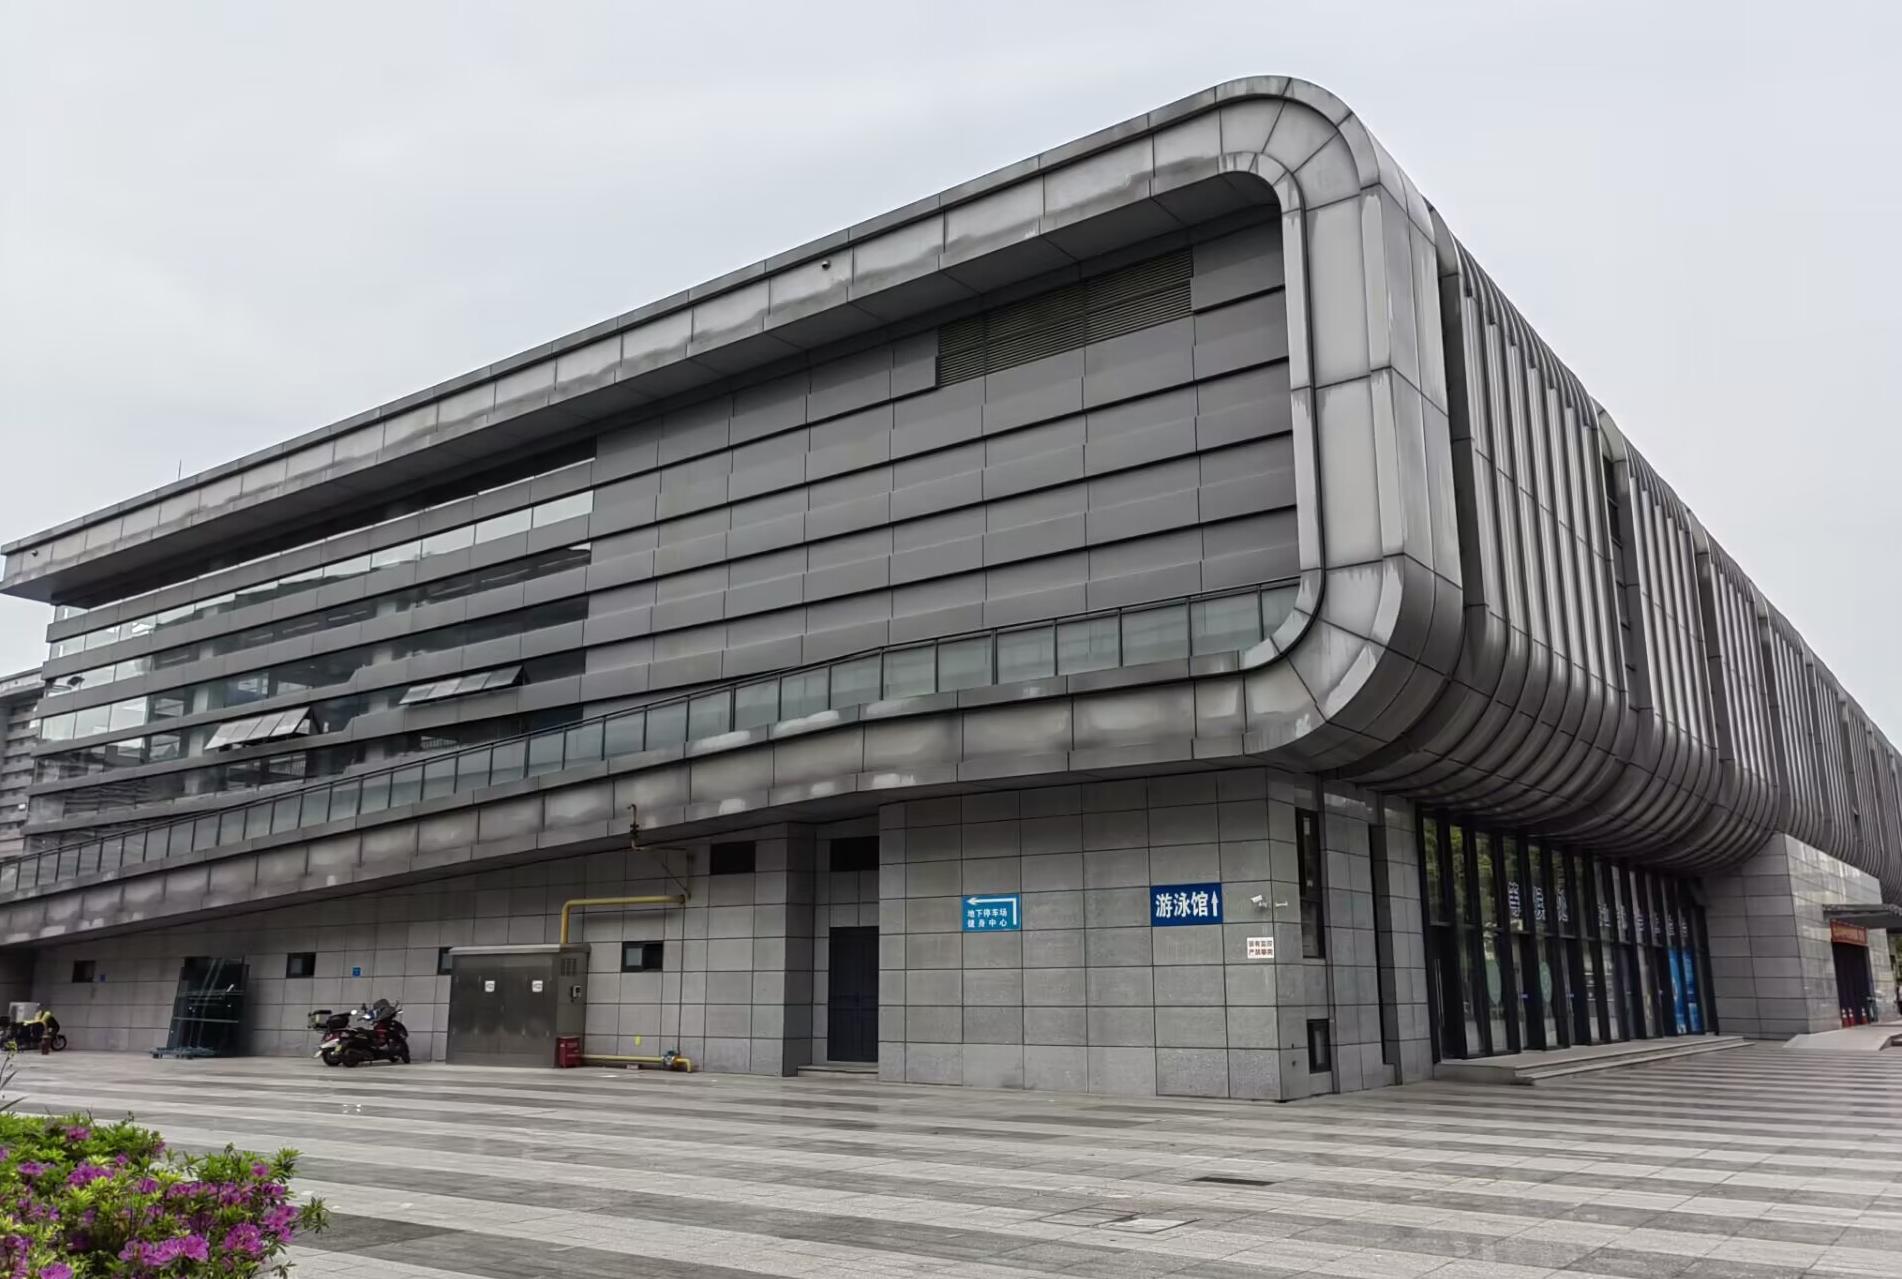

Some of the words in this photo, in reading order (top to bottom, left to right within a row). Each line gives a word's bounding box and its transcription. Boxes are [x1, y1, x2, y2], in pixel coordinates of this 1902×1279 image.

[967, 908, 1008, 918] 地下停车场
[1155, 891, 1209, 918] 游泳馆
